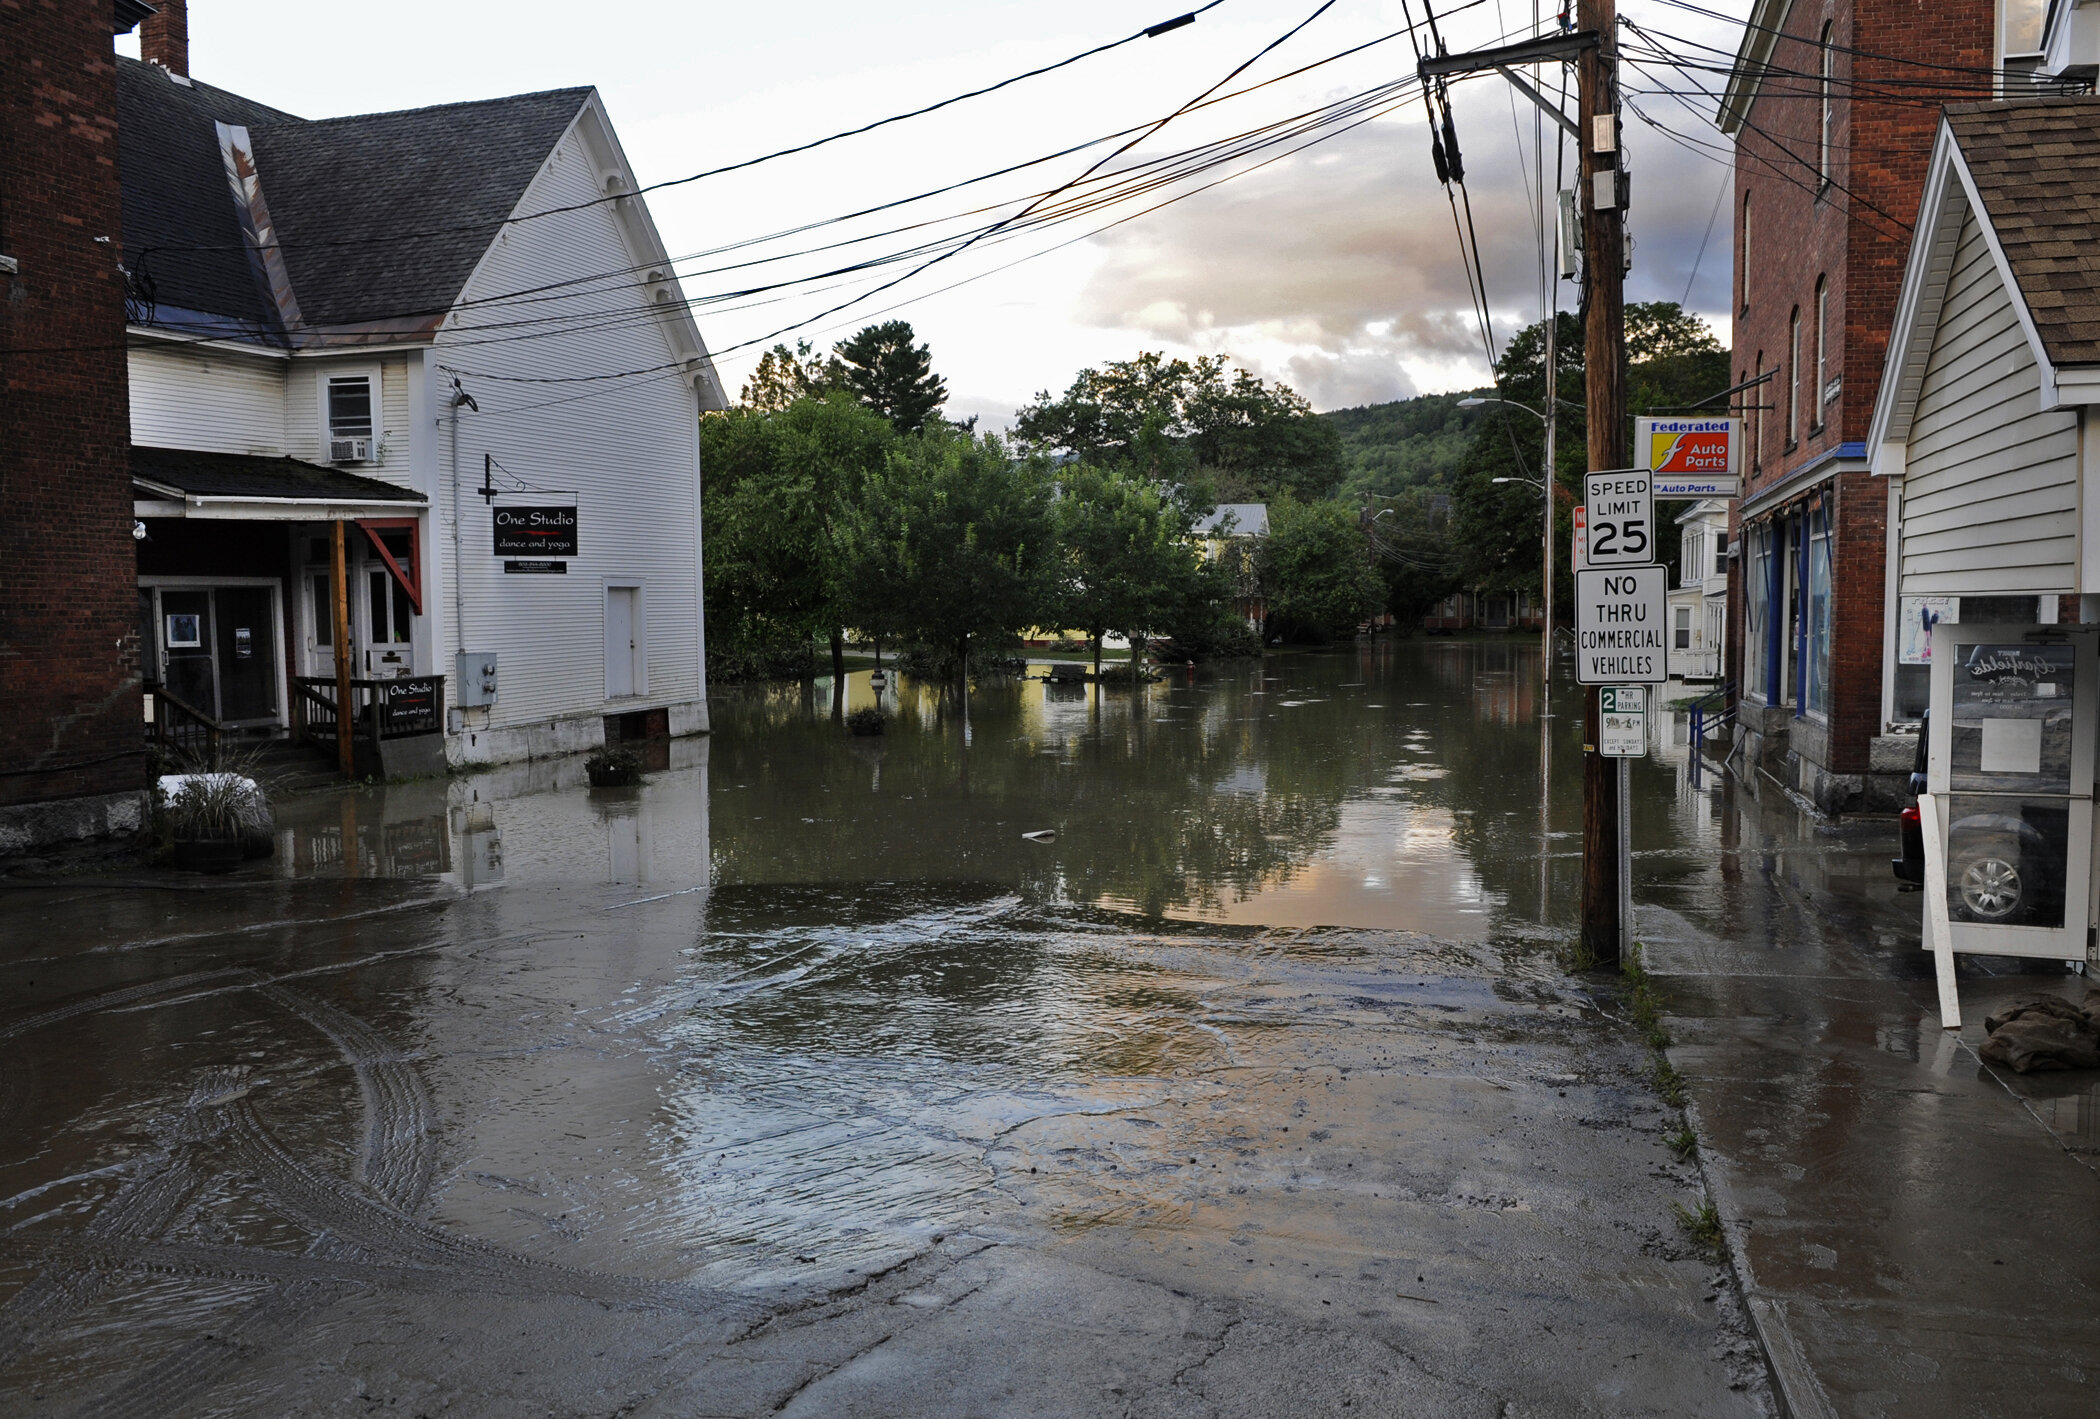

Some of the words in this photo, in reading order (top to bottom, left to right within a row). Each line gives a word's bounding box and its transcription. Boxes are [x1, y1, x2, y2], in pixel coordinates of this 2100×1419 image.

[1651, 421, 1730, 432] Federated
[1690, 443, 1726, 455] Auto
[1685, 456, 1726, 467] Parts
[1590, 479, 1648, 496] SPEED
[1661, 484, 1686, 493] Auto
[1687, 484, 1716, 493] Parts
[1596, 500, 1641, 516] LIMIT
[496, 512, 526, 525] One
[529, 511, 574, 525] Studio
[499, 538, 526, 547] dance
[528, 538, 546, 547] and
[547, 541, 571, 550] yoga
[1592, 519, 1648, 556] 25
[1603, 575, 1637, 596] NO
[1595, 603, 1647, 622] THRU
[1581, 630, 1662, 649] COMMERCIAL
[1591, 656, 1652, 675] VEHICLES
[390, 685, 407, 696] One
[408, 682, 432, 694] Studio
[1602, 692, 1615, 709] 2
[1624, 691, 1634, 700] HR
[1617, 701, 1642, 710] PARKING
